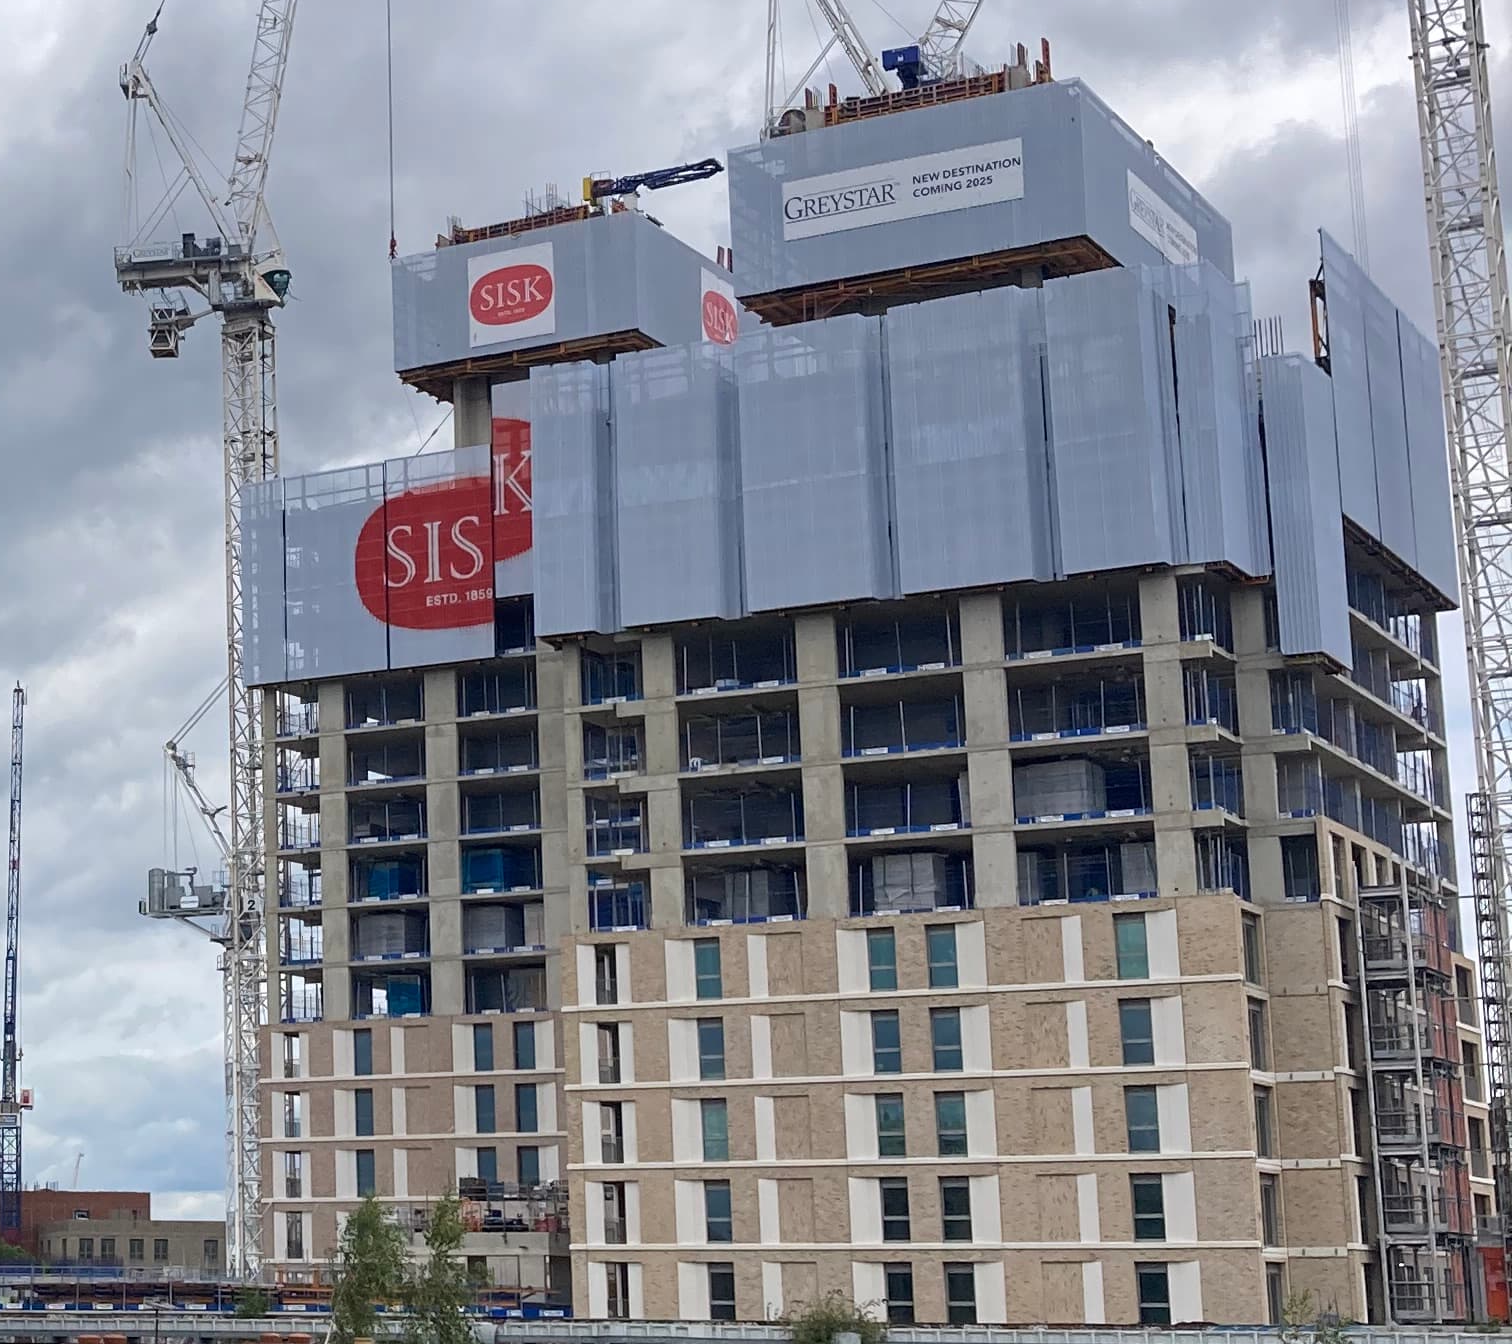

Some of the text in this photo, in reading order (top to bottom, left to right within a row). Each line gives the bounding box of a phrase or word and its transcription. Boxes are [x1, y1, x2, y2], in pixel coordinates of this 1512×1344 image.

[912, 157, 1021, 185] NEW DESTINATION
[912, 175, 993, 198] COMING 2025
[785, 184, 895, 220] GREYSTAR
[479, 275, 545, 311] SISK
[706, 302, 736, 340] SISK
[426, 587, 493, 607] ESTD. 1859
[247, 899, 256, 911] 2
